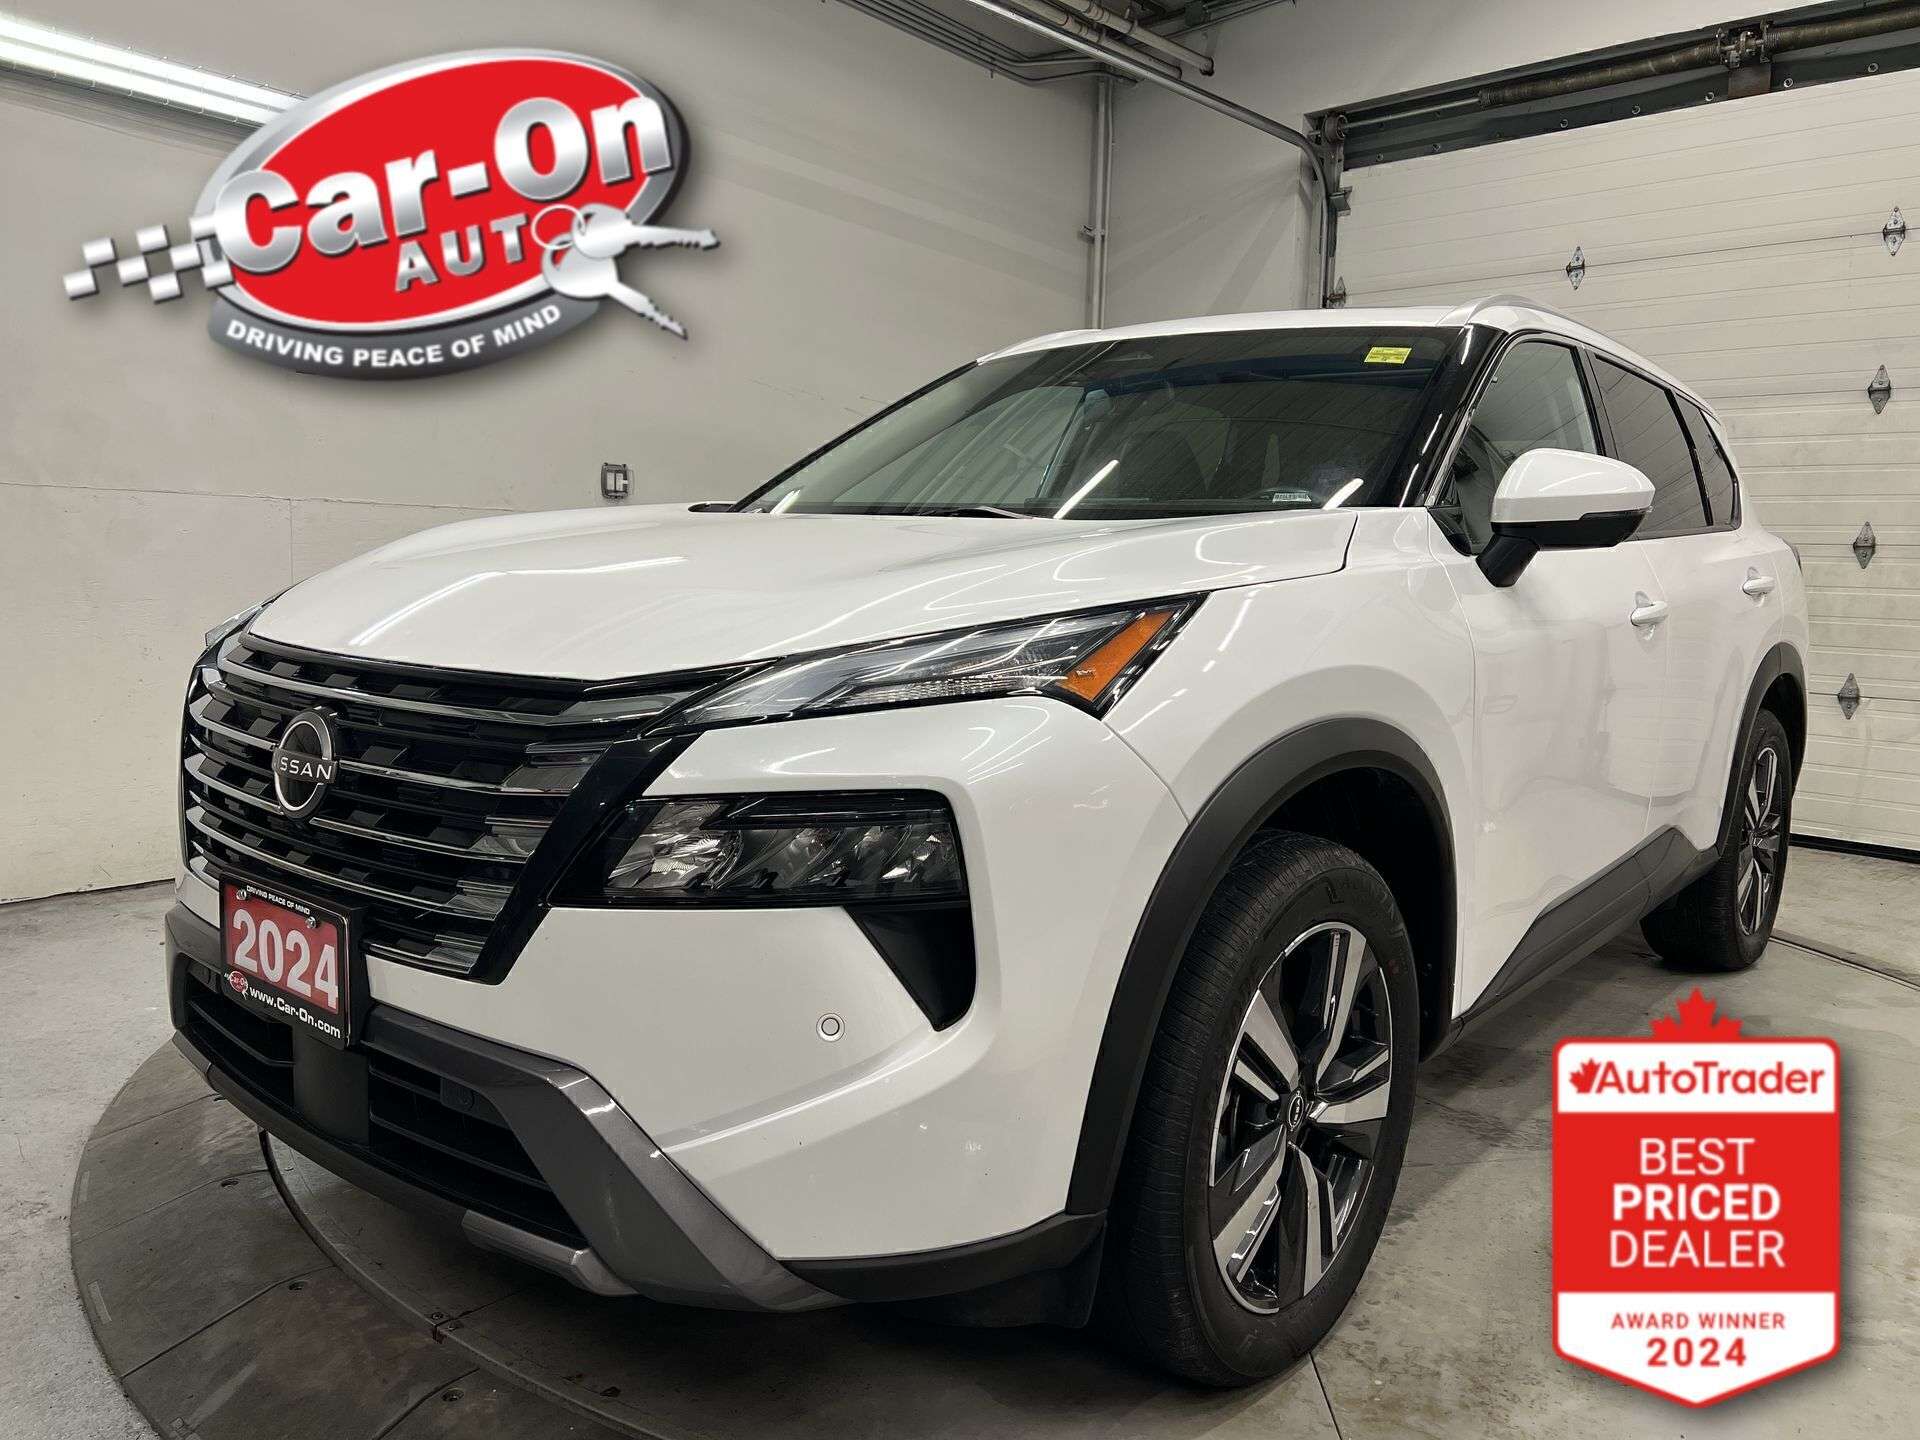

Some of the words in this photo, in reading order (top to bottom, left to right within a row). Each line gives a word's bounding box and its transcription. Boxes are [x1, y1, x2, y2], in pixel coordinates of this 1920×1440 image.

[279, 756, 333, 780] SSAN
[246, 885, 268, 899] DRIVING
[268, 893, 287, 906] PEACE
[286, 900, 295, 909] OF
[295, 903, 311, 915] MIND
[232, 908, 340, 1010] 2024
[249, 986, 342, 1040] www.Car-On.com
